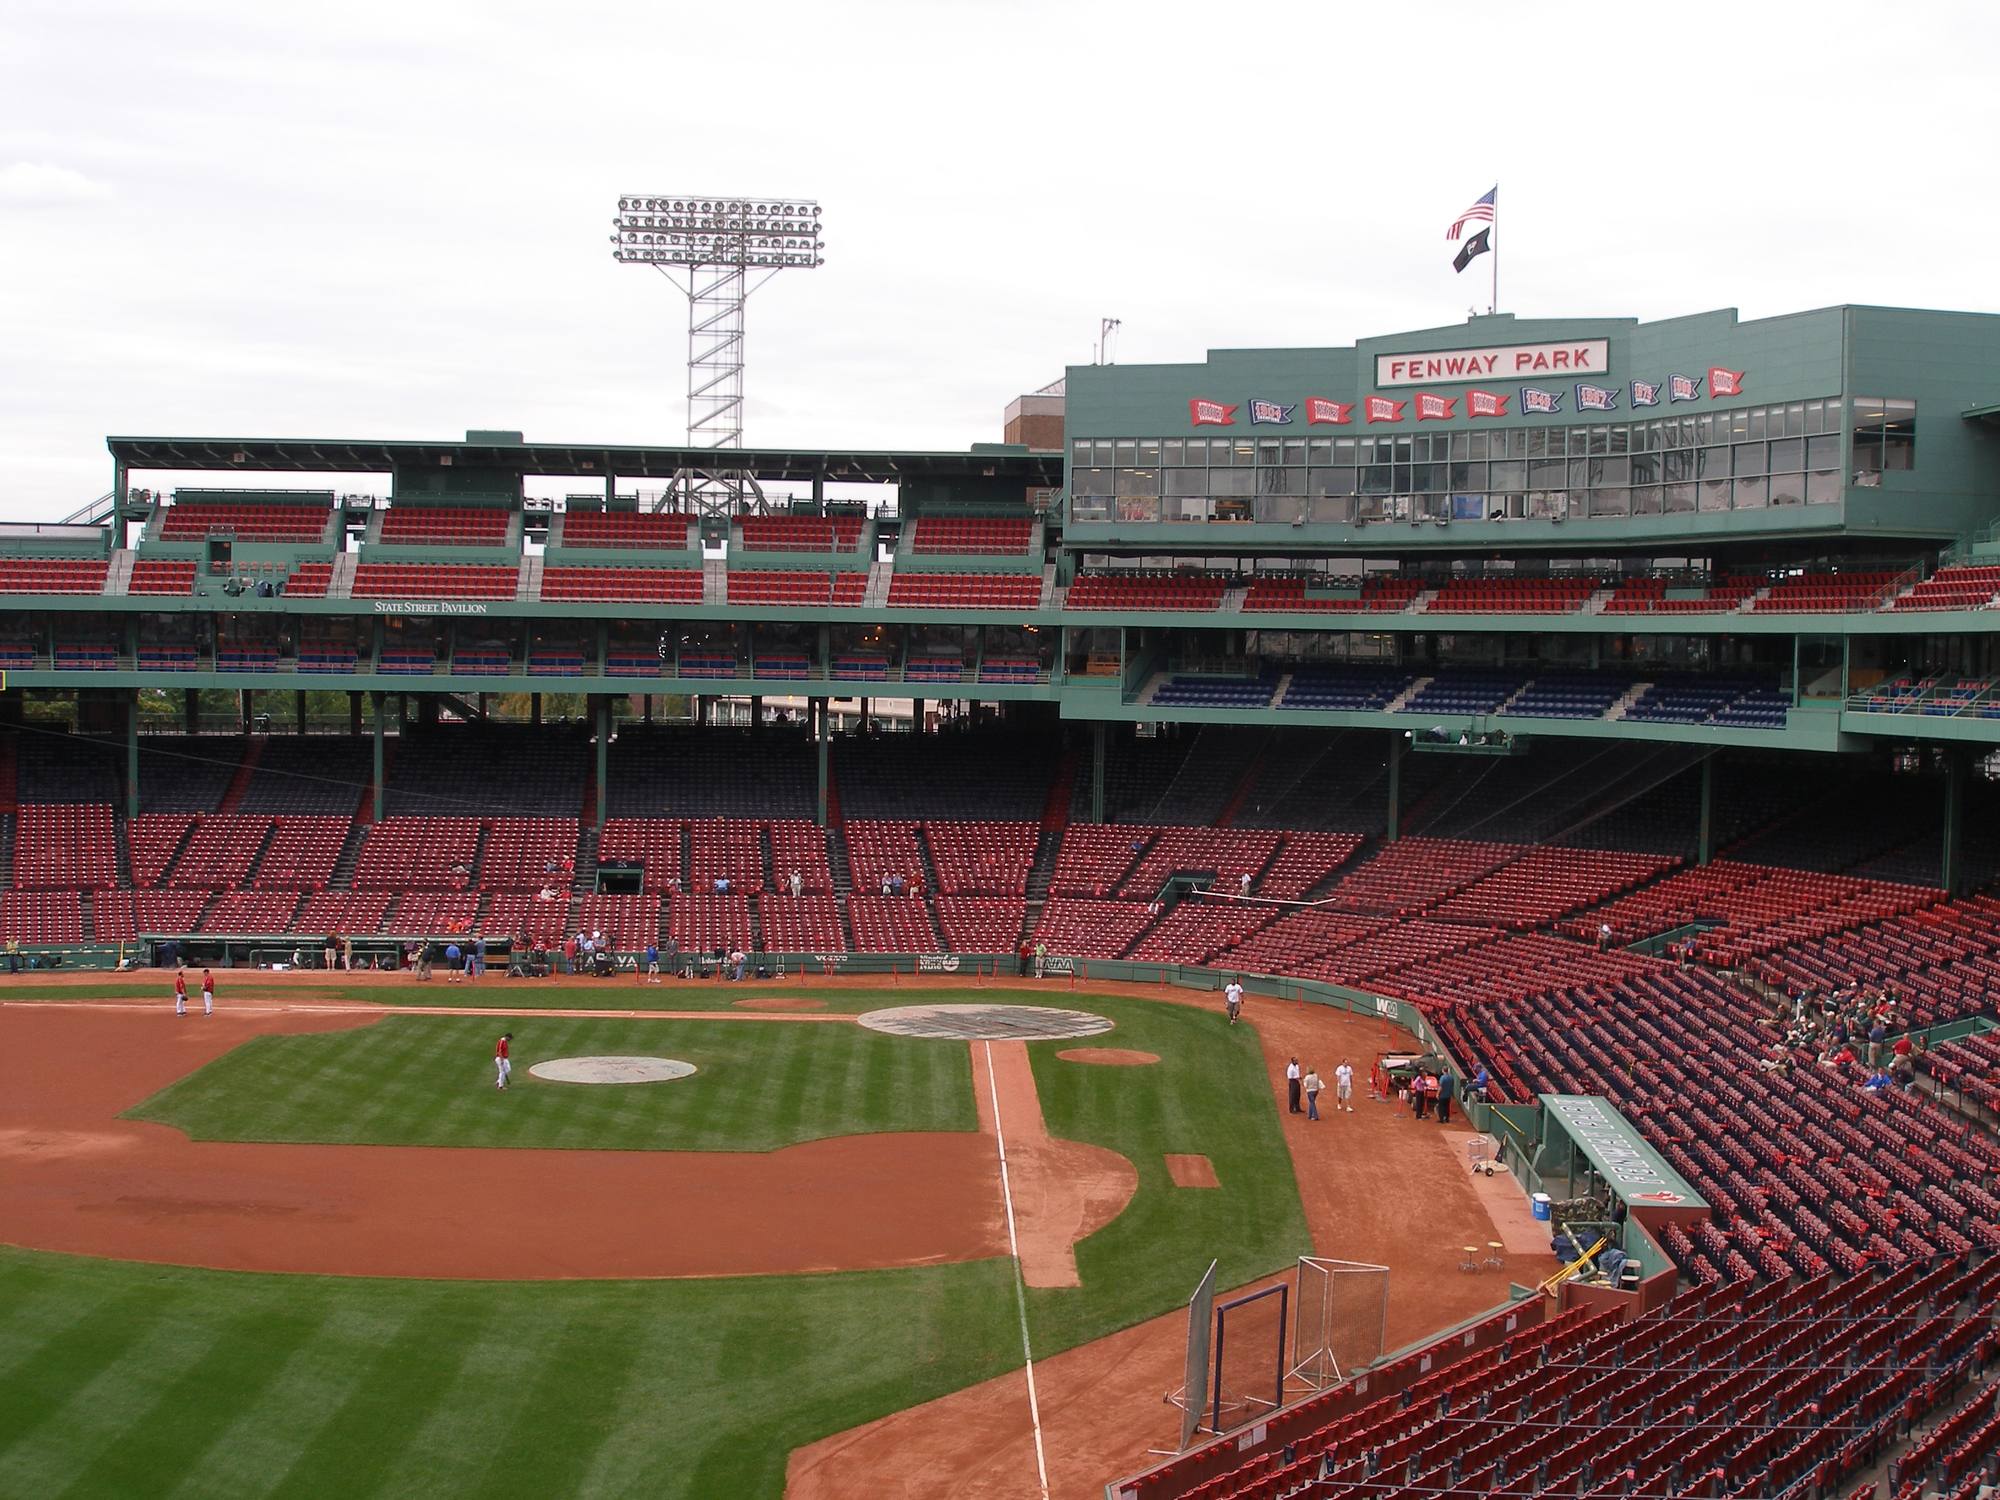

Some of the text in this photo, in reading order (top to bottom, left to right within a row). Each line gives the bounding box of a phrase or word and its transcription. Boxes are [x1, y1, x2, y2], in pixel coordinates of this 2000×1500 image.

[1391, 348, 1590, 380] FENWAY PARK
[1255, 404, 1282, 421] 1904
[375, 601, 487, 613] STATE STREET PAVILION
[1577, 1127, 1666, 1185] FENWAY
